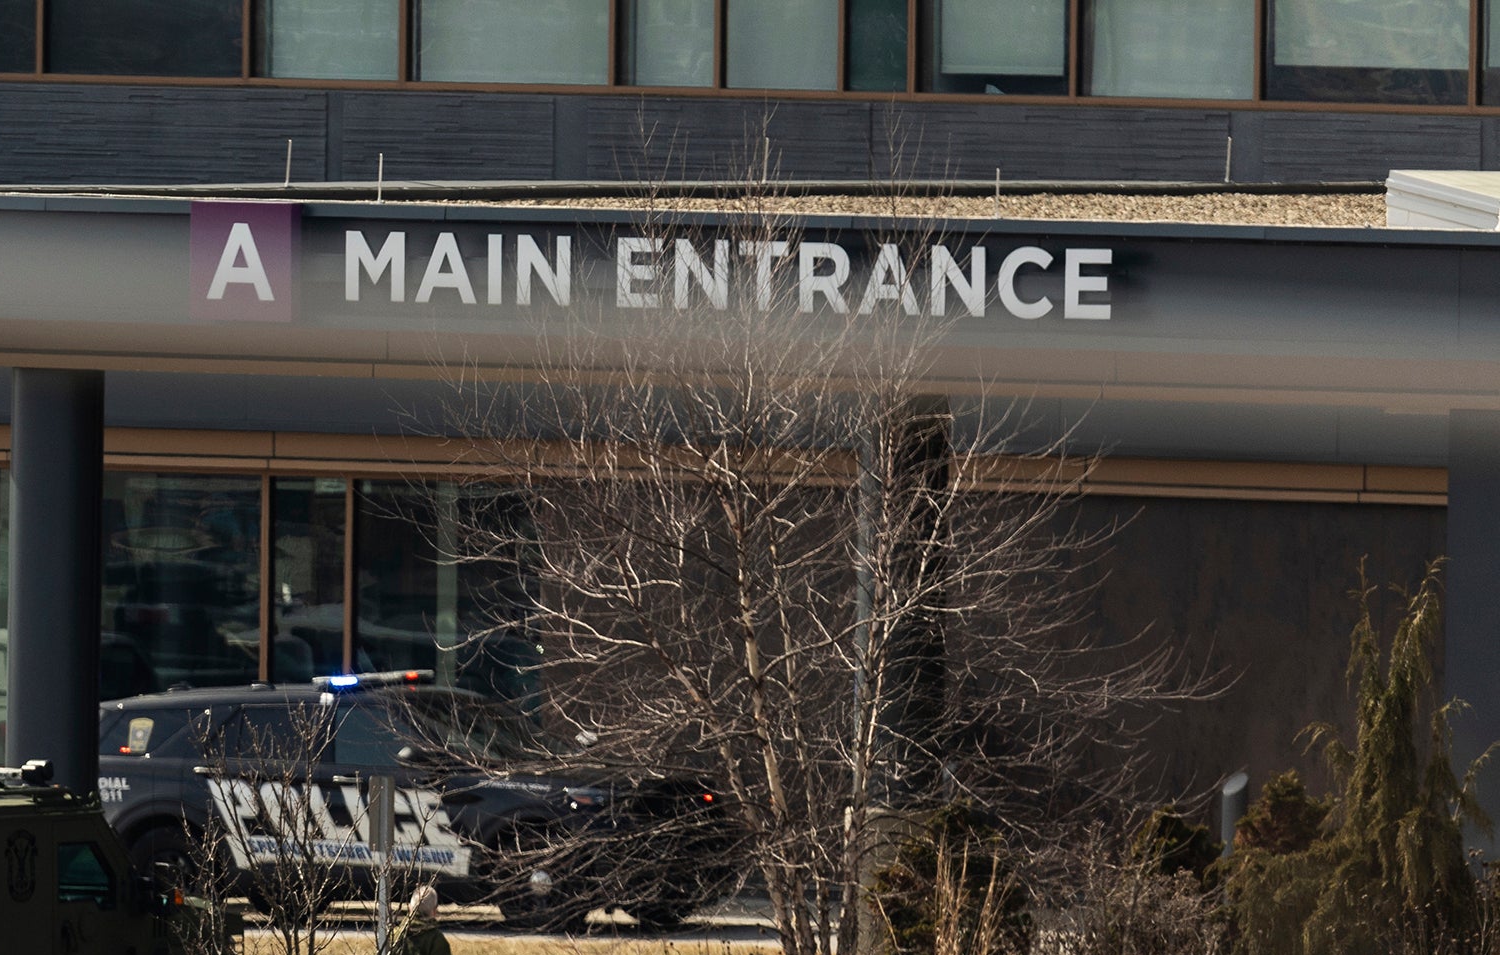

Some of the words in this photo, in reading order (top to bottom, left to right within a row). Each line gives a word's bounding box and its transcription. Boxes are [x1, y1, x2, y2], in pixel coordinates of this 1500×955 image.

[205, 222, 275, 302] A
[345, 230, 572, 307] MAIN
[616, 236, 1112, 320] ENTRANCE
[98, 777, 131, 791] DIAL
[100, 789, 123, 802] 911
